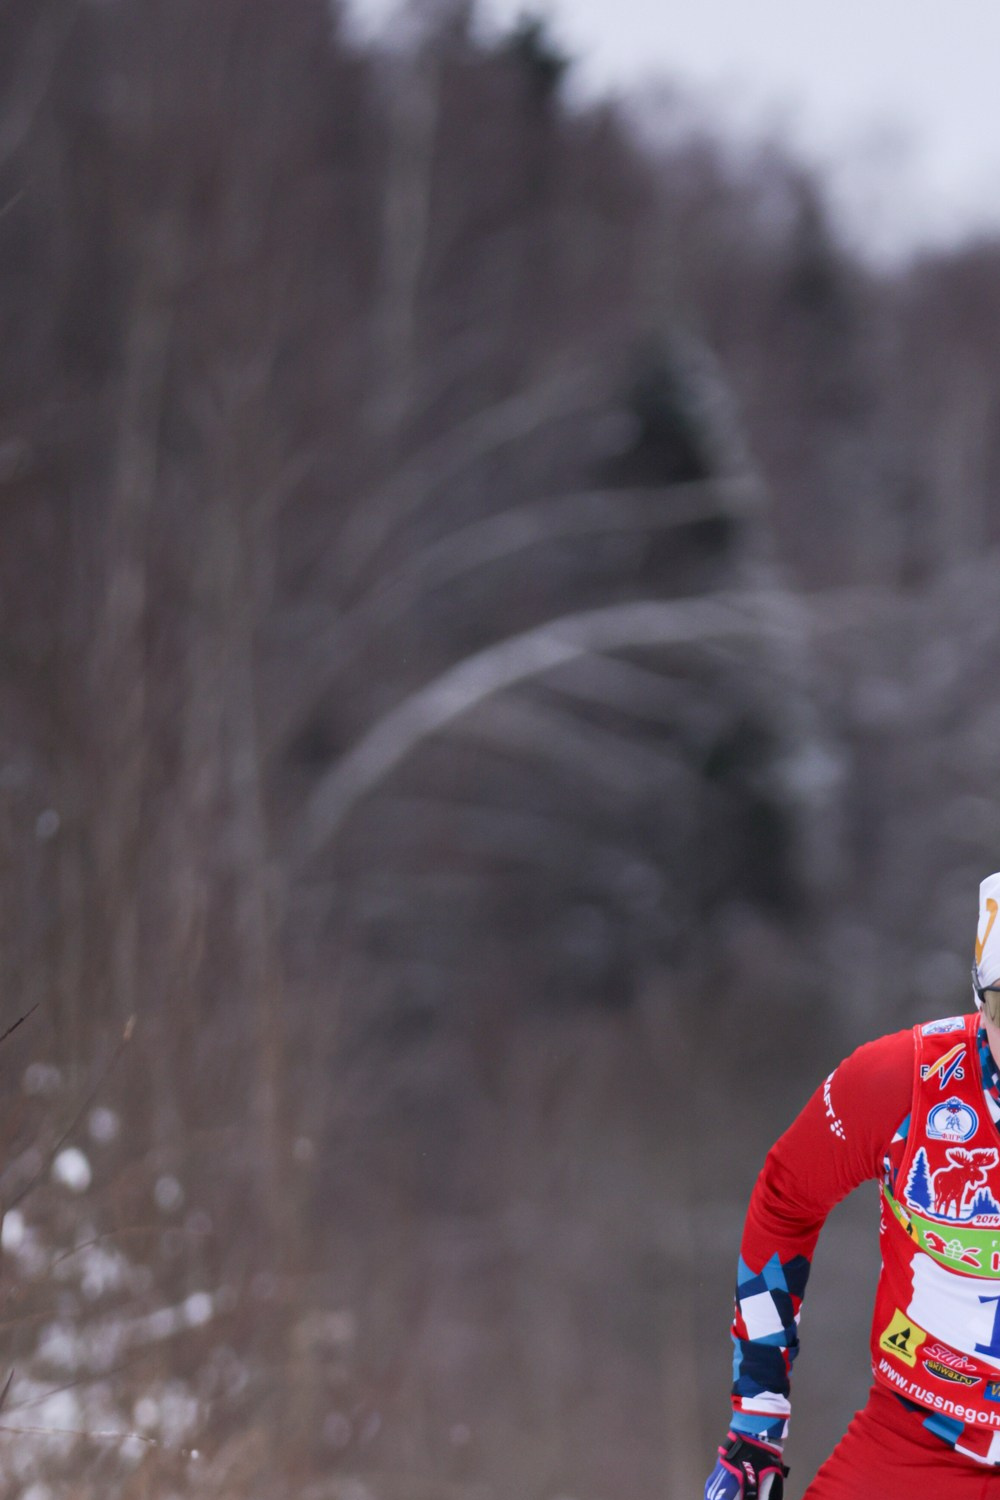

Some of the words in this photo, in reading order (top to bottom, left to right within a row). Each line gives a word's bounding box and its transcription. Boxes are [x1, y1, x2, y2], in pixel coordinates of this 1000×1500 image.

[823, 1068, 838, 1119] RAFT
[976, 1214, 1000, 1225] 2014
[927, 1360, 973, 1386] skiwax.ru
